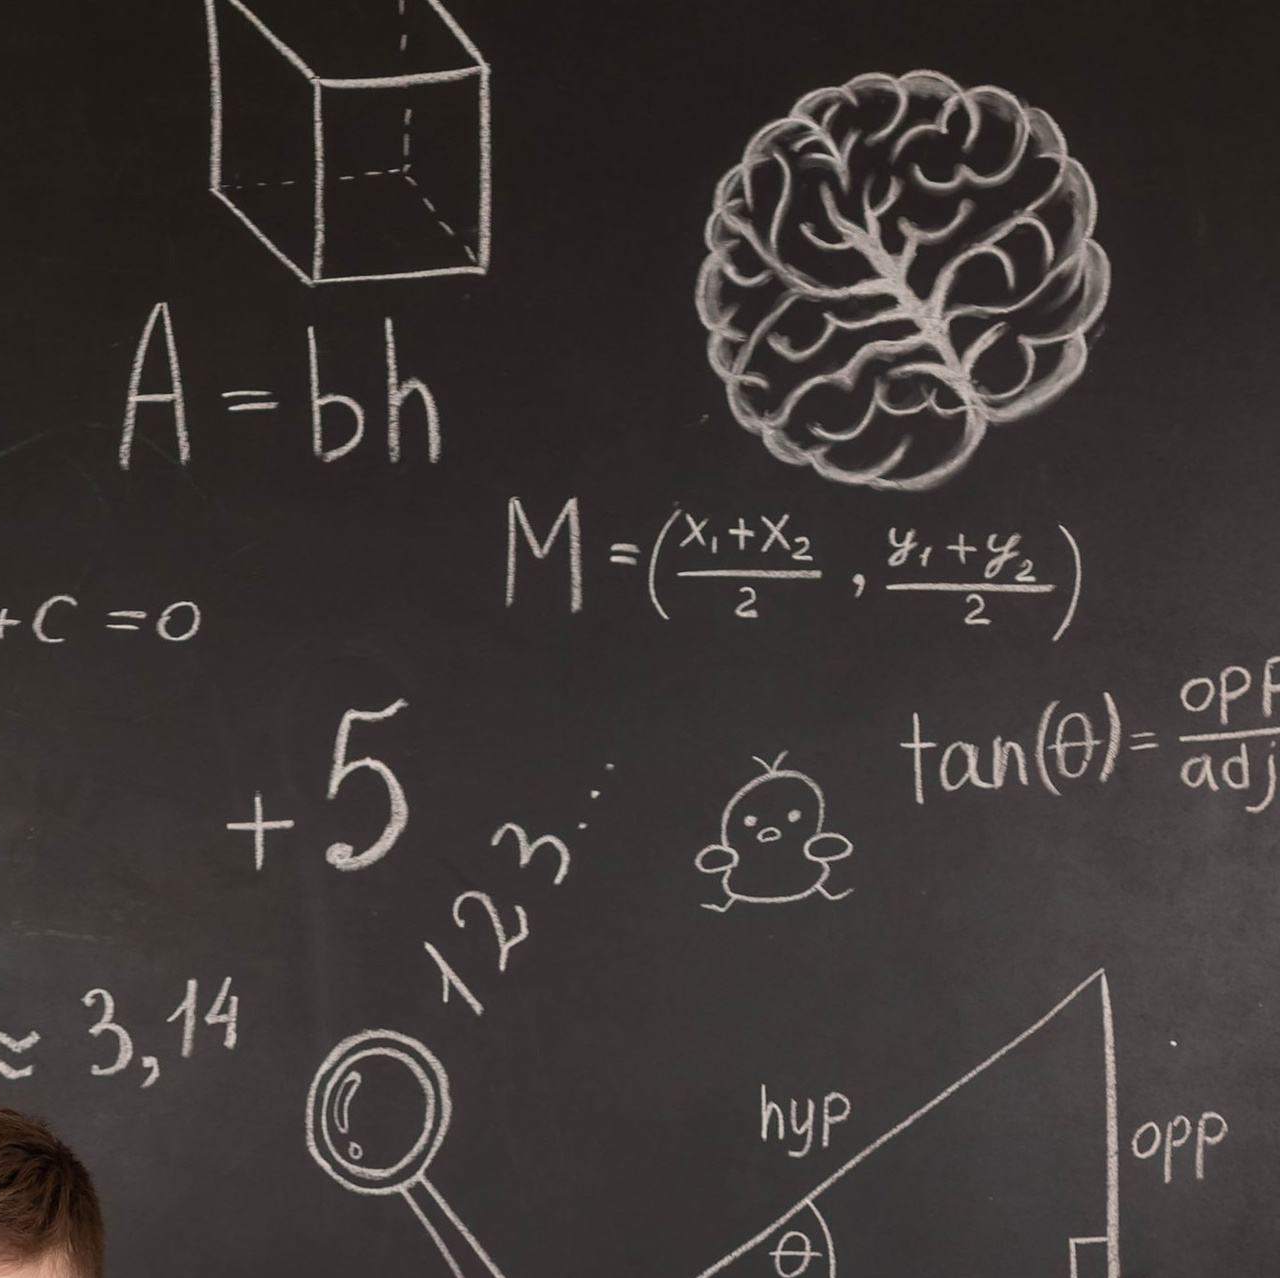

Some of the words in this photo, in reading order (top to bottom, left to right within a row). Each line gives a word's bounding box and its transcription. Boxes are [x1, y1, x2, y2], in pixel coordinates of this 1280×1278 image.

[1179, 738, 1276, 813] adj
[81, 977, 238, 1087] 3,14
[761, 1084, 851, 1158] hyp
[1132, 1112, 1228, 1183] opp
